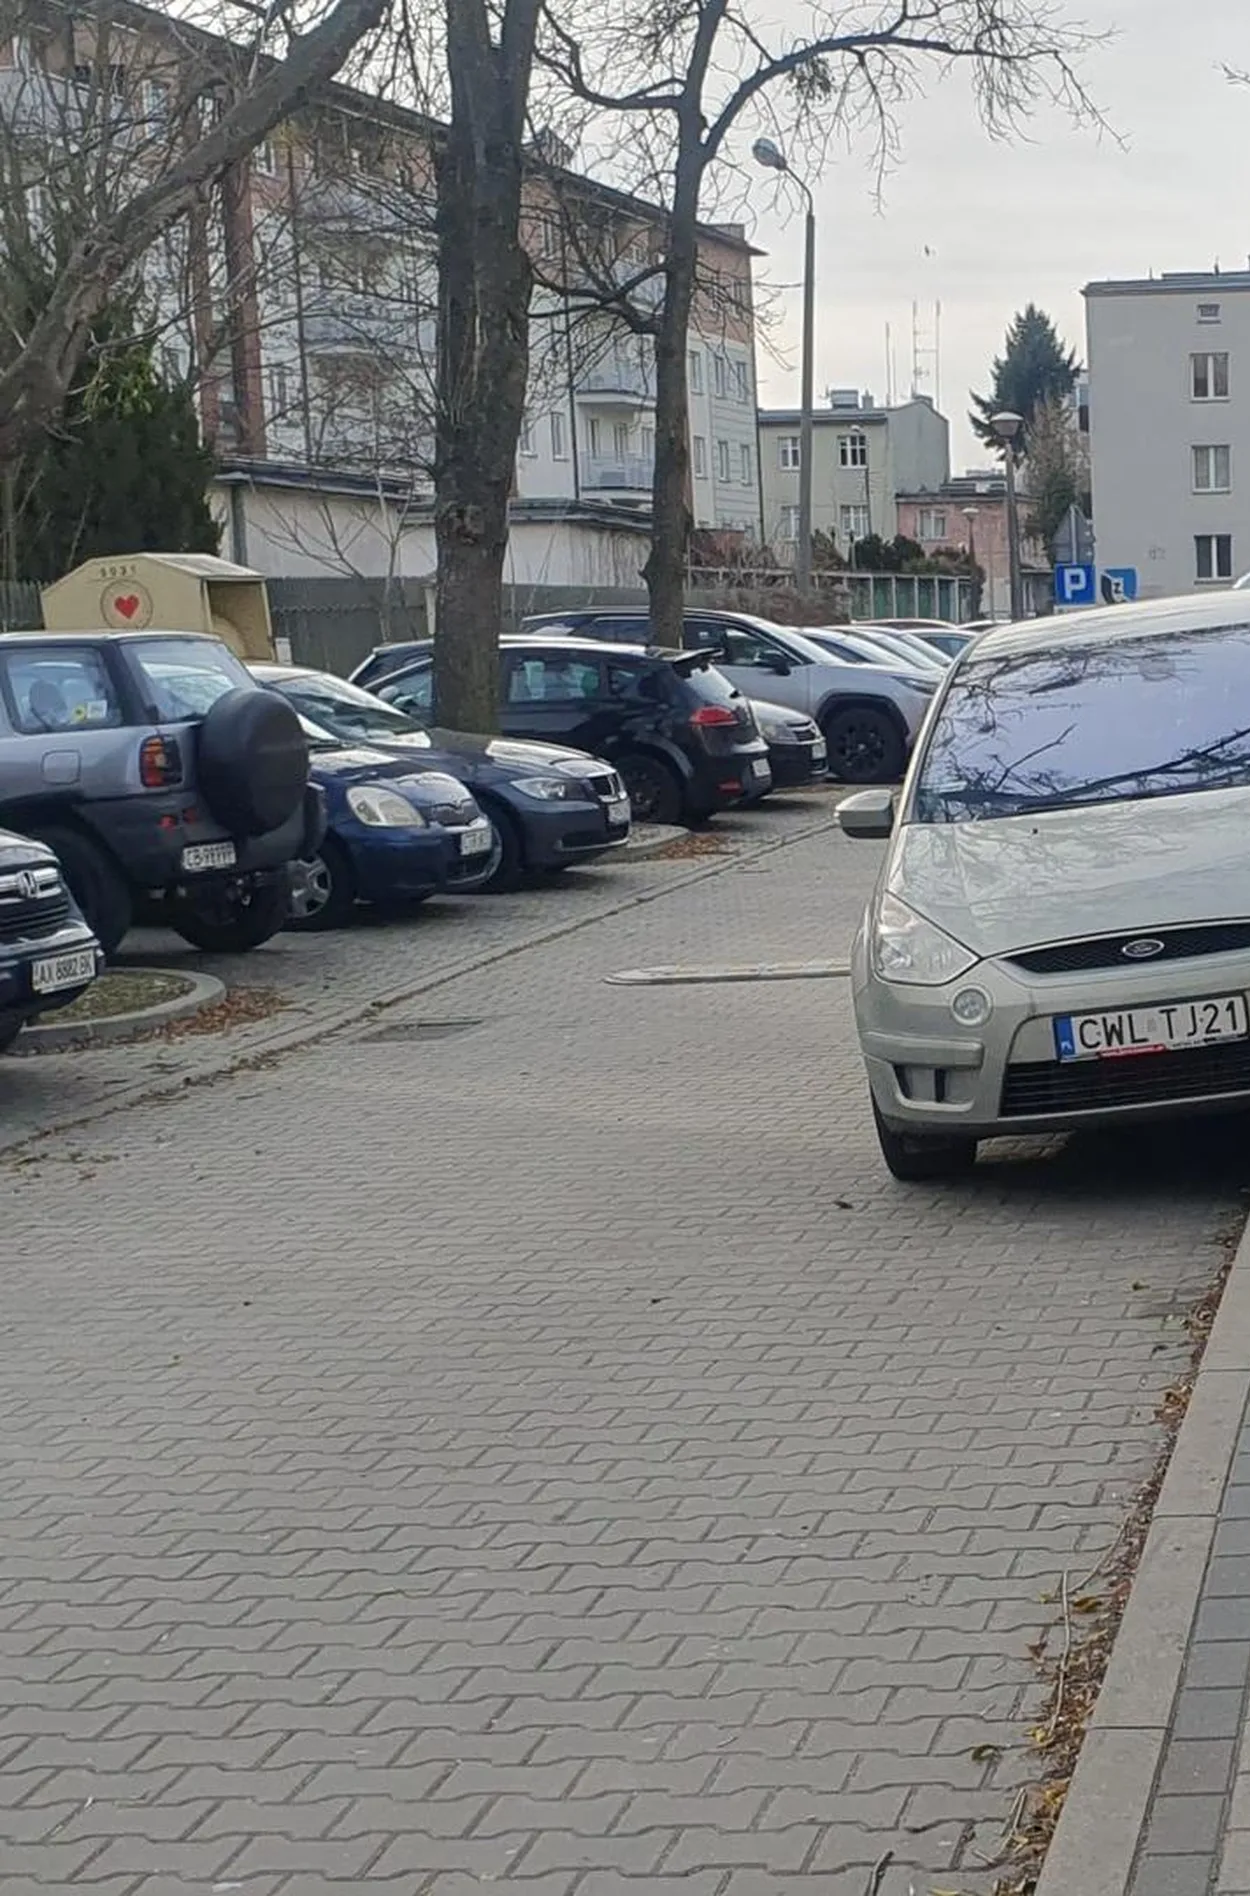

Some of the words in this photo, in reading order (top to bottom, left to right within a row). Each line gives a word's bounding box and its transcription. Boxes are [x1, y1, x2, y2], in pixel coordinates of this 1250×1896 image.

[1064, 568, 1087, 600] P
[1079, 1013, 1150, 1050] CWL
[1159, 1000, 1238, 1041] TJ21
